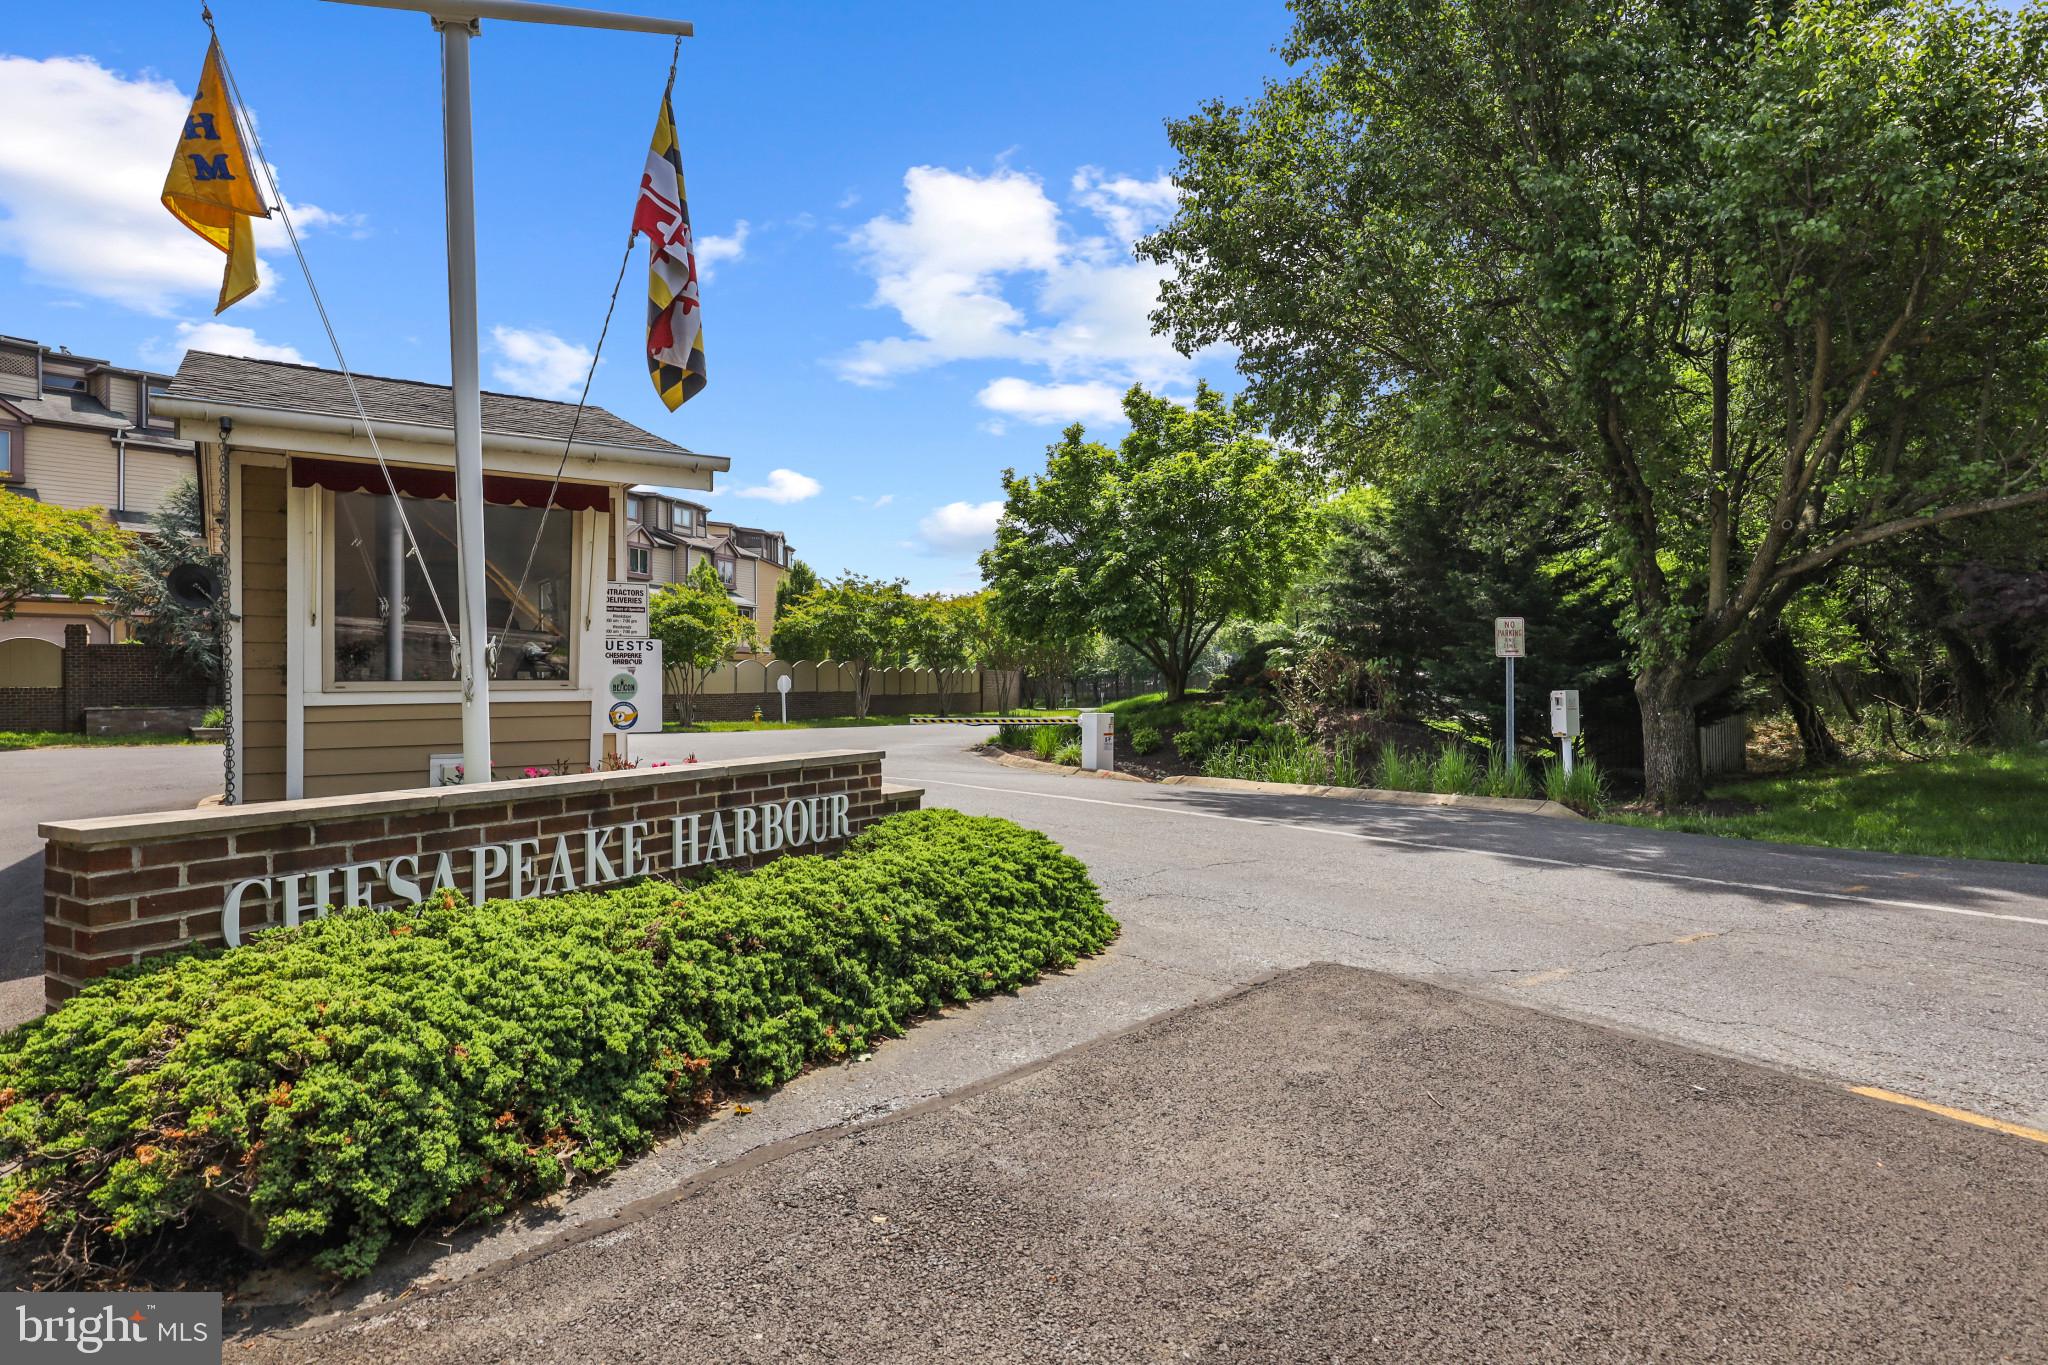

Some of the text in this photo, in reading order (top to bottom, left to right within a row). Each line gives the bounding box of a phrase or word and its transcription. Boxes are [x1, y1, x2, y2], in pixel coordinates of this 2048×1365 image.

[188, 153, 236, 181] M
[1497, 629, 1522, 637] PARKING
[1504, 621, 1515, 629] NO
[221, 794, 851, 948] CHESAPEAKE HARBOUR
